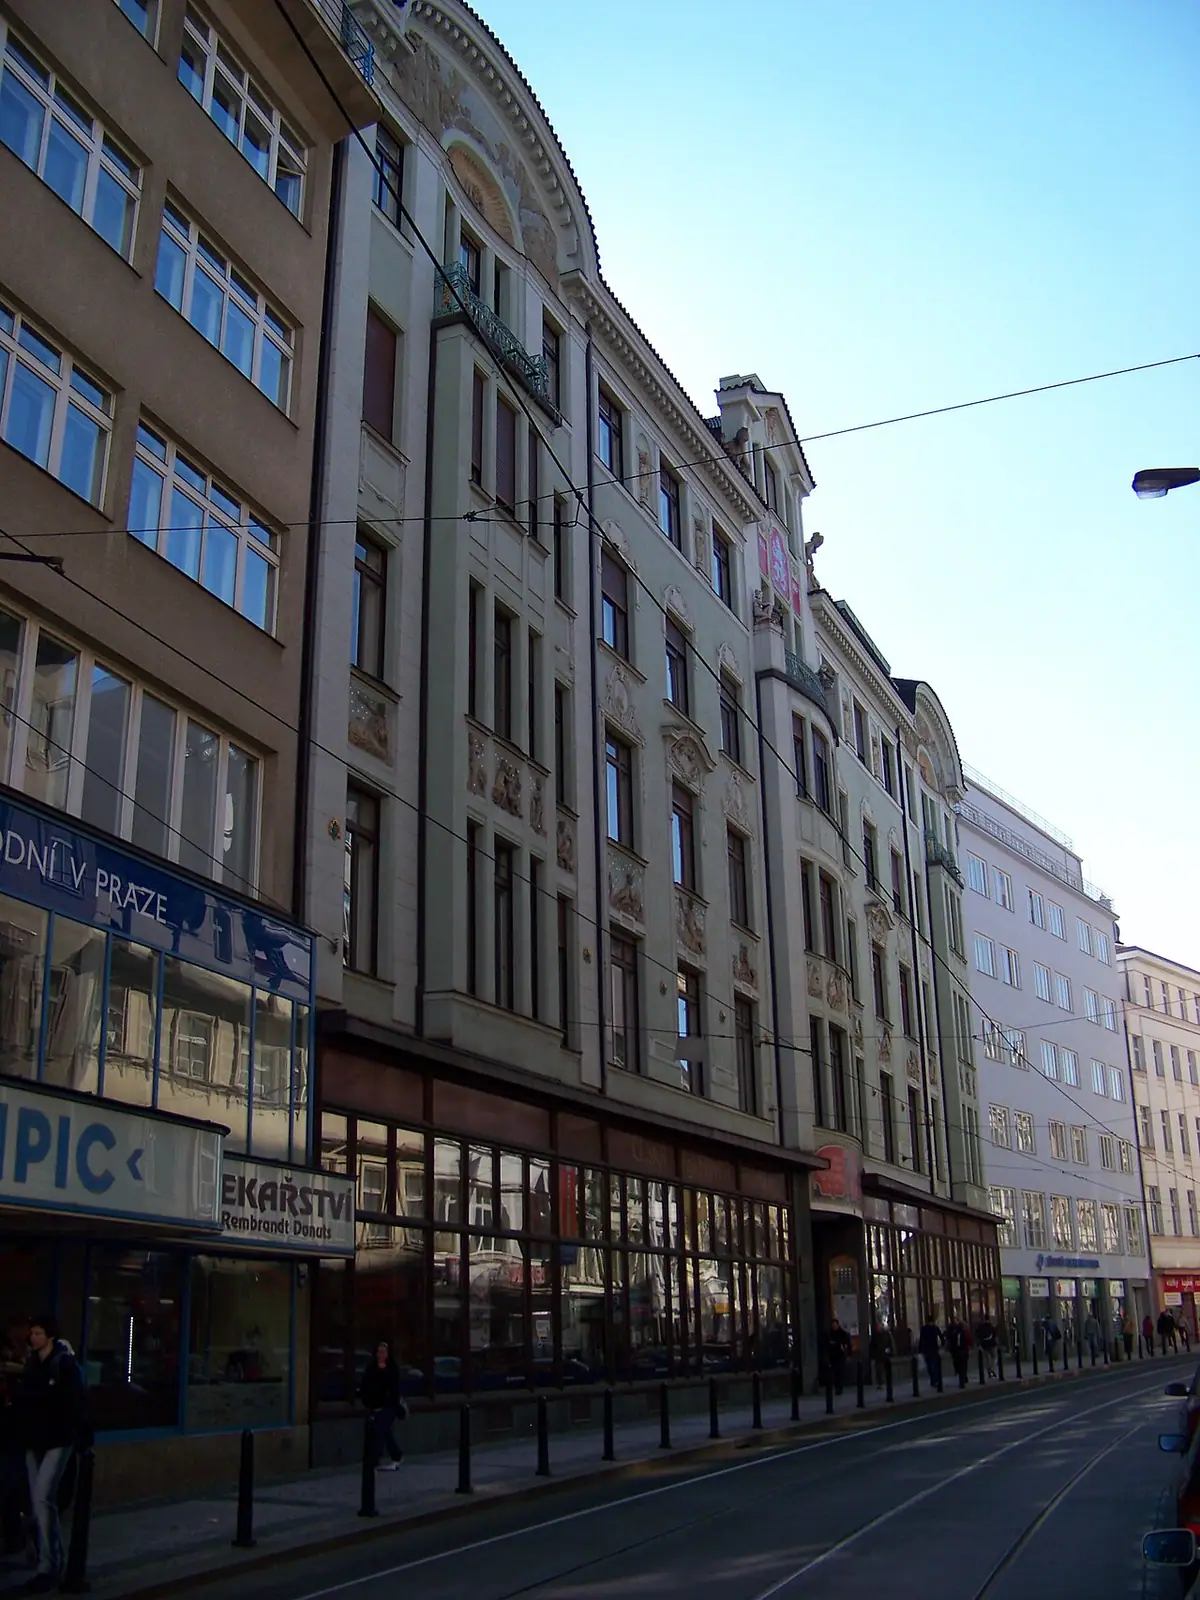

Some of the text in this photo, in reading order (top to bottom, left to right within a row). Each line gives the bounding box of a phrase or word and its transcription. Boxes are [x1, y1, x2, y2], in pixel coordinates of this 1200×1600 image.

[0, 829, 58, 880] DNÍ
[70, 856, 87, 889] V
[0, 1103, 117, 1195] PIC
[221, 1211, 332, 1240] Rembrandt Donuts
